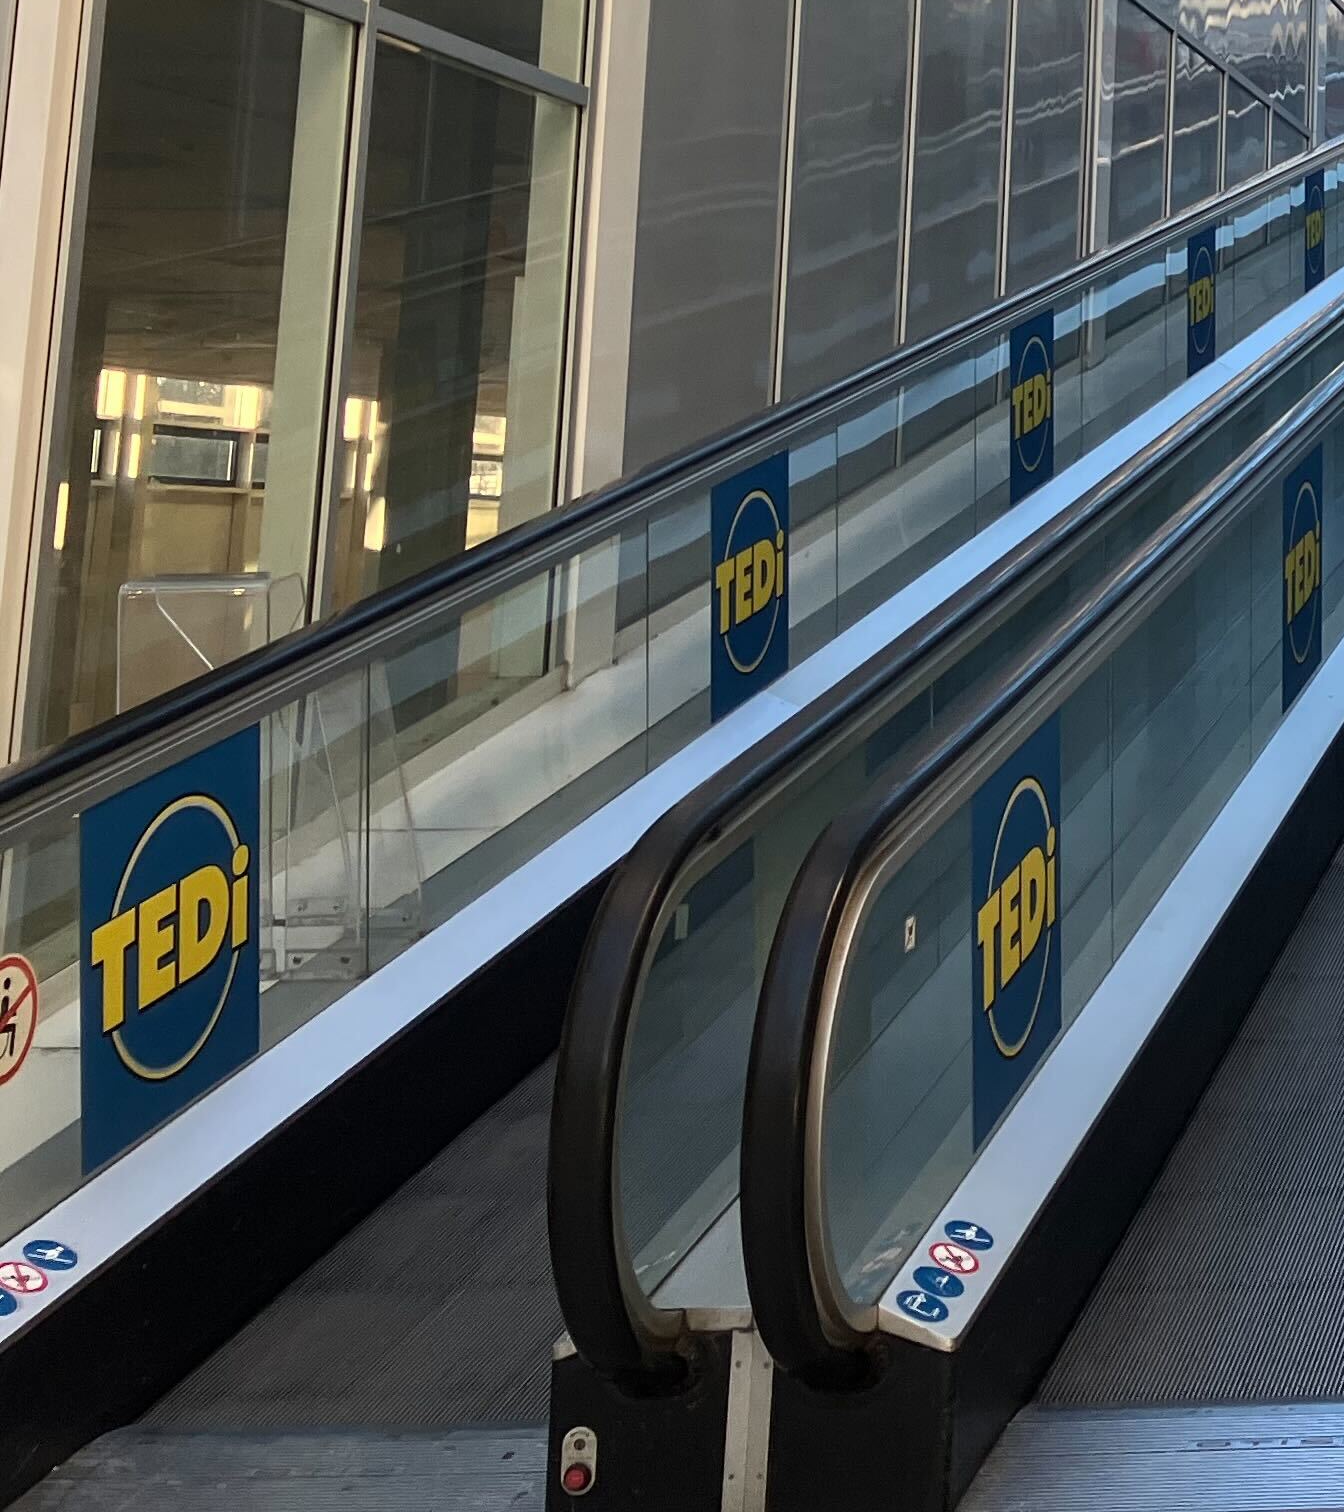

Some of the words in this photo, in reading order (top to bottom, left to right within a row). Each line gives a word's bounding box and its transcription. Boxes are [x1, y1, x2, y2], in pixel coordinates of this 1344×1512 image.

[1012, 368, 1051, 440] TEDi
[715, 529, 785, 635] TEDi
[1285, 520, 1320, 624] TEDi
[91, 843, 250, 1034] TEDi
[977, 826, 1056, 1012] TEDi
